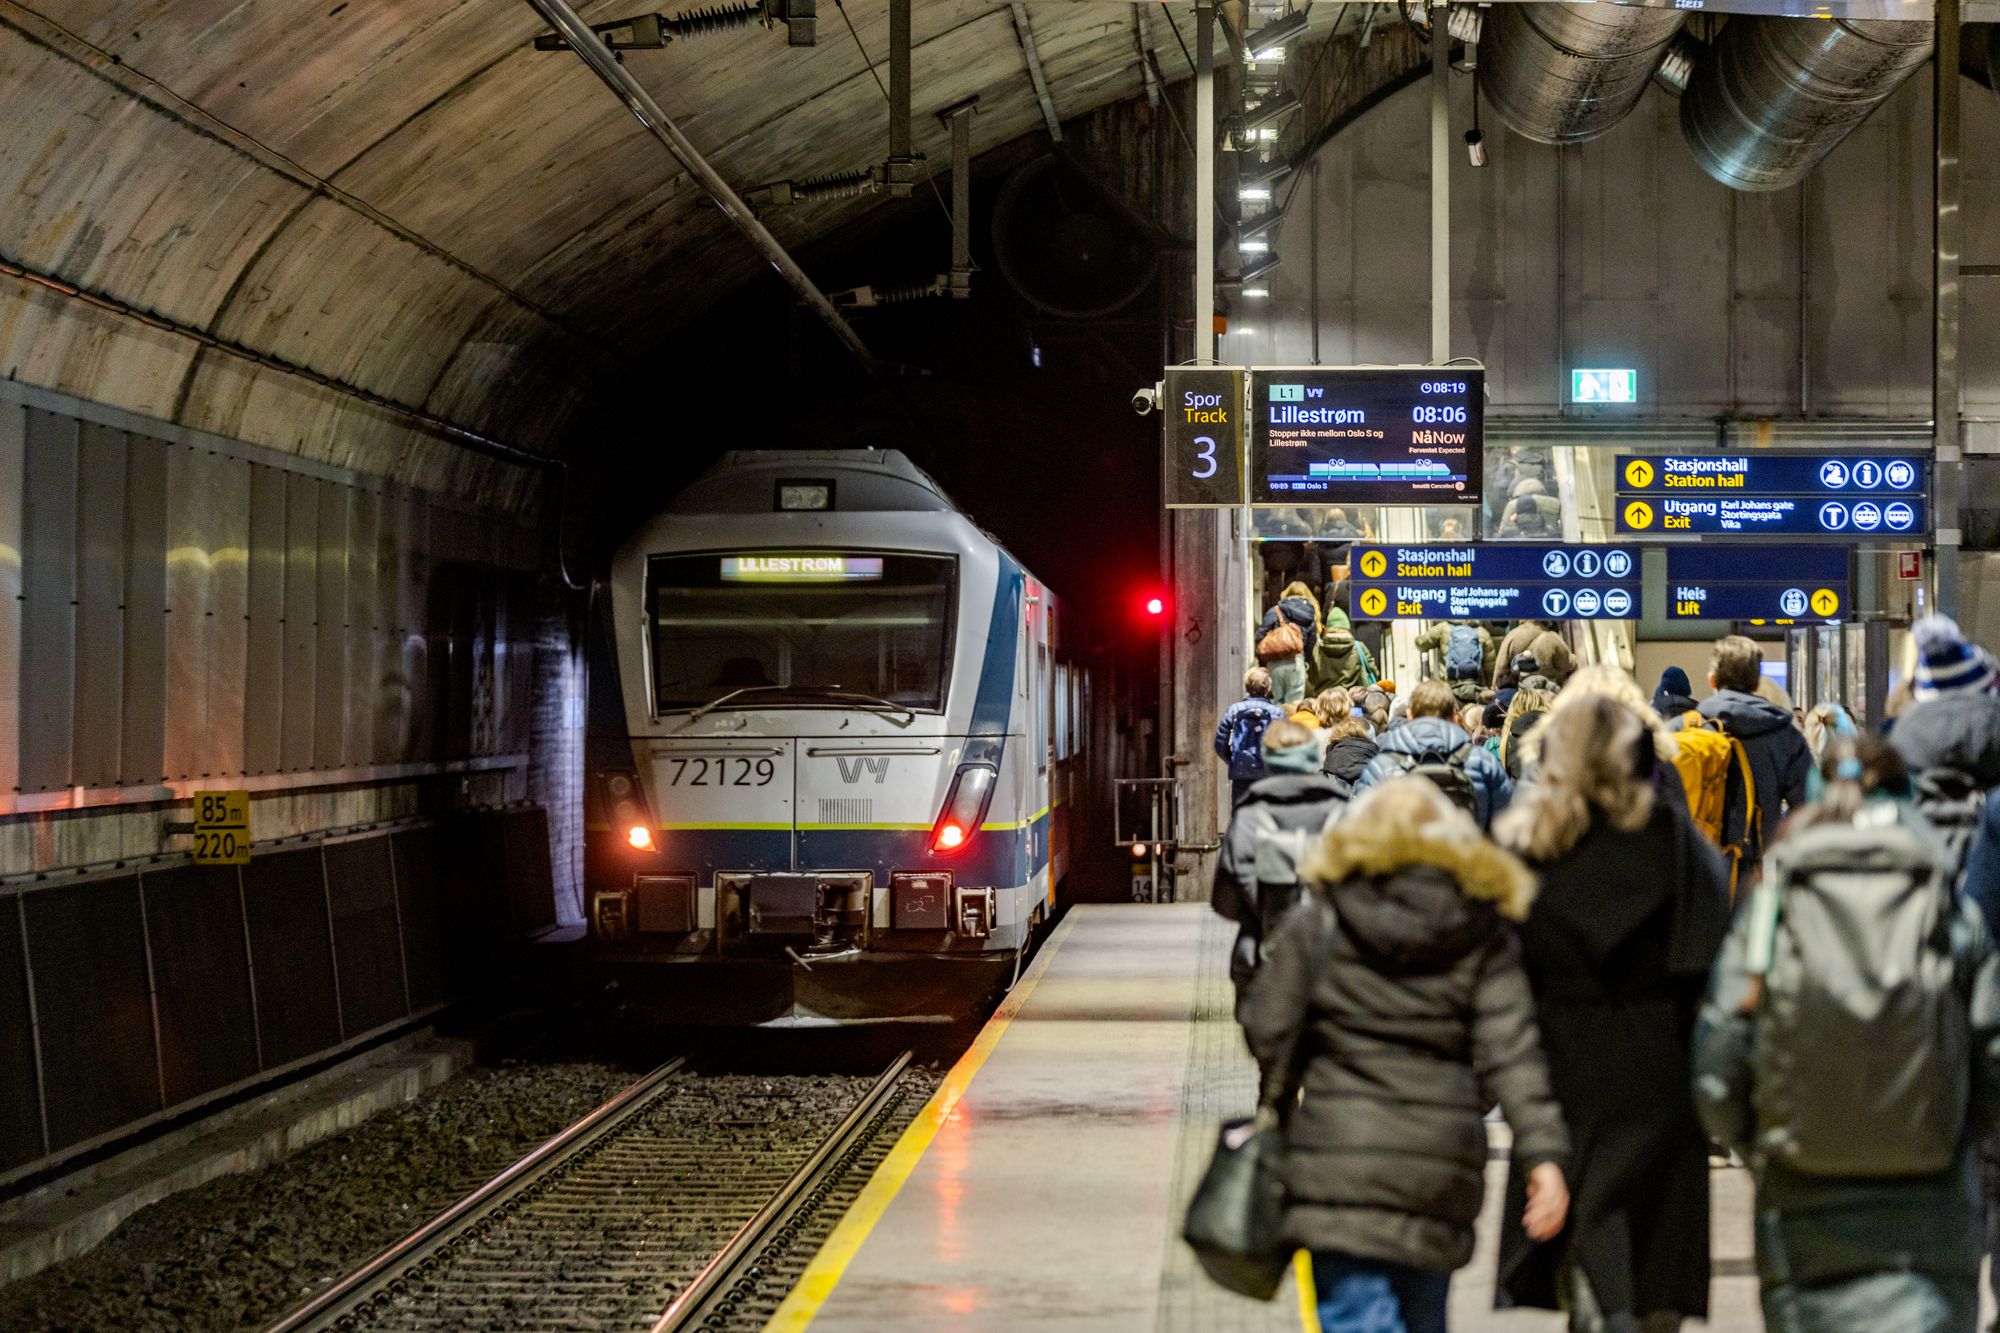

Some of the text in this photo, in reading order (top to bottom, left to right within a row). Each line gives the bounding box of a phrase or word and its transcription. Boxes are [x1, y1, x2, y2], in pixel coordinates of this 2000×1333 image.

[1433, 383, 1466, 393] 08:19
[1184, 391, 1221, 409] Spor
[1184, 408, 1228, 423] Track
[1270, 406, 1365, 424] Lillestrøm
[1412, 406, 1467, 423] 08:06
[1269, 429, 1384, 439] Stopper ikke mellom Oslo S og
[1269, 439, 1307, 447] Lillestrøm
[1192, 436, 1218, 479] 3
[1438, 447, 1466, 455] Expected
[1664, 458, 1748, 474] Stasjonshall
[1664, 473, 1744, 487] Station hall
[1664, 500, 1717, 516] Utgang
[1720, 500, 1795, 512] Karl Johans gate
[1664, 515, 1691, 529] Exit
[1720, 510, 1782, 521] Stortingsgata
[1720, 520, 1742, 529] Vika
[1397, 548, 1476, 564] Stasjonshall
[1397, 563, 1472, 577] Station hall
[1397, 587, 1447, 603] Utgang
[1450, 587, 1519, 598] Karl Johans gate
[1676, 586, 1707, 600] Heis
[1397, 602, 1423, 615] Exit
[1450, 597, 1508, 608] Stortingsgata
[1676, 601, 1700, 615] Lift
[1450, 606, 1470, 615] Vika
[670, 757, 774, 786] 72129
[202, 796, 226, 822] 85
